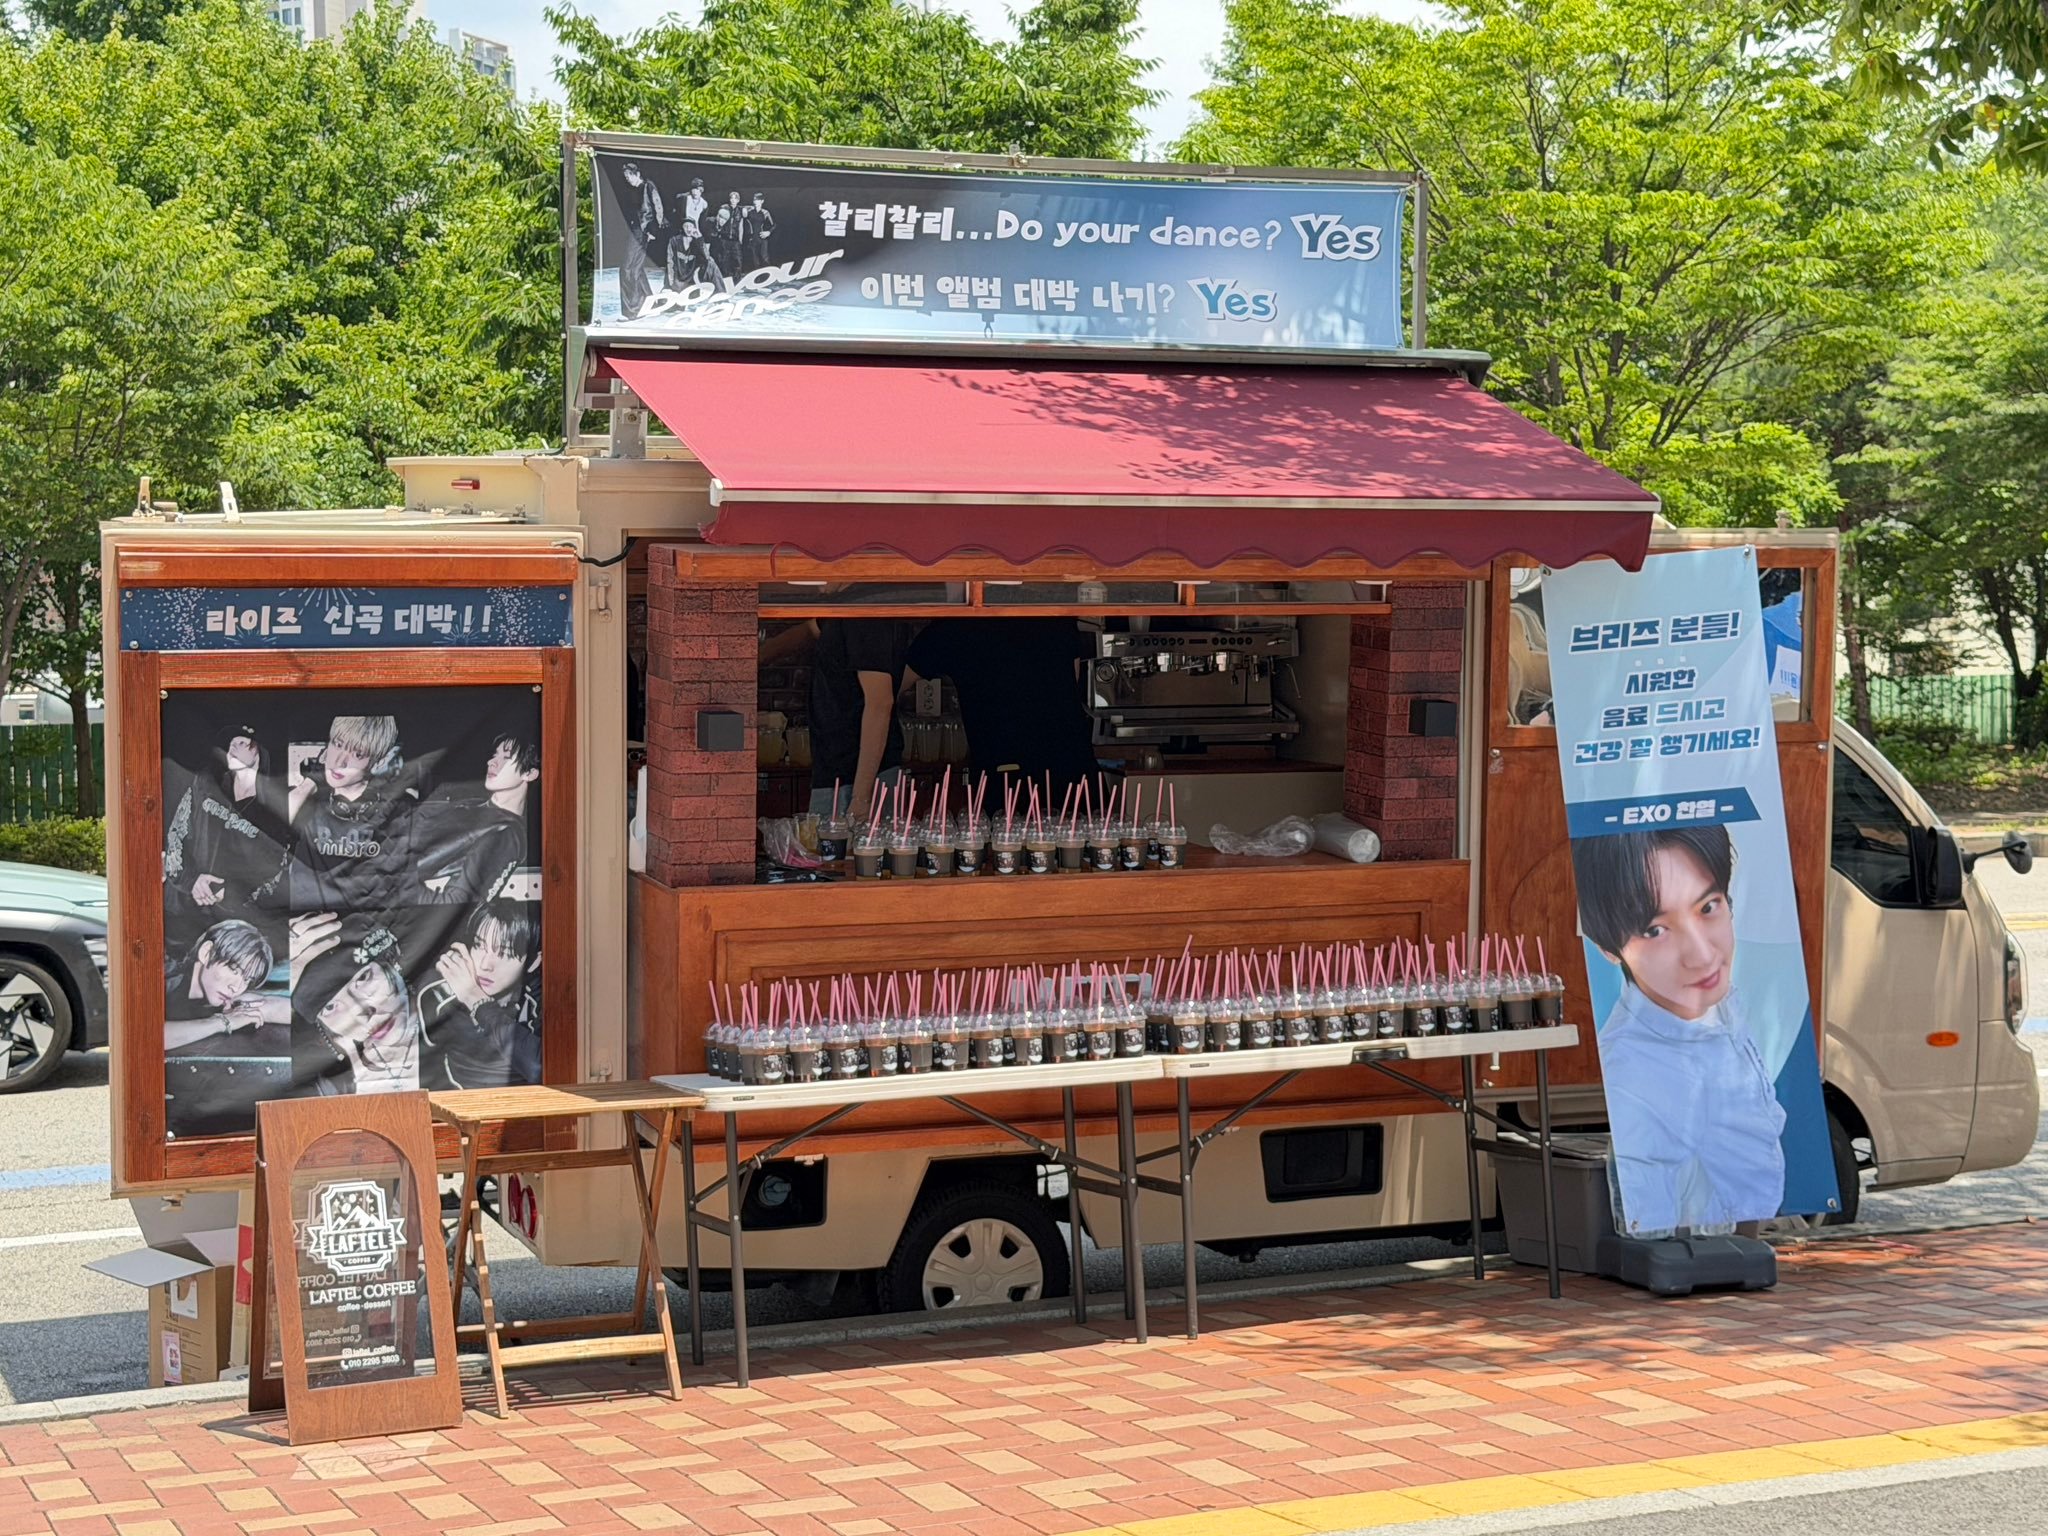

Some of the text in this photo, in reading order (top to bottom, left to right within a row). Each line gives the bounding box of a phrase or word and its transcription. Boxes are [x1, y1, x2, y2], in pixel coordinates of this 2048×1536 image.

[1053, 220, 1140, 247] your
[1149, 216, 1282, 251] dance?
[1290, 213, 1382, 262] Yes
[860, 272, 1277, 322] 이번 앨범 대박 나기? Yes
[206, 605, 302, 636] 라이즈
[323, 604, 384, 636] 신곡
[1569, 611, 1741, 653] 브리즈 분들!
[1624, 668, 1696, 695] 시원한
[1602, 698, 1726, 729] 음료 드시고
[1575, 727, 1761, 764] 건강 잘 챙기세요!
[1623, 799, 1717, 825] EXO 찬열
[328, 1231, 388, 1254] LAFTEL
[347, 1256, 372, 1265] COFFEE
[309, 1280, 417, 1305] LAFTEL COFFEE
[337, 1301, 361, 1312] coffee
[348, 1359, 362, 1368] 010
